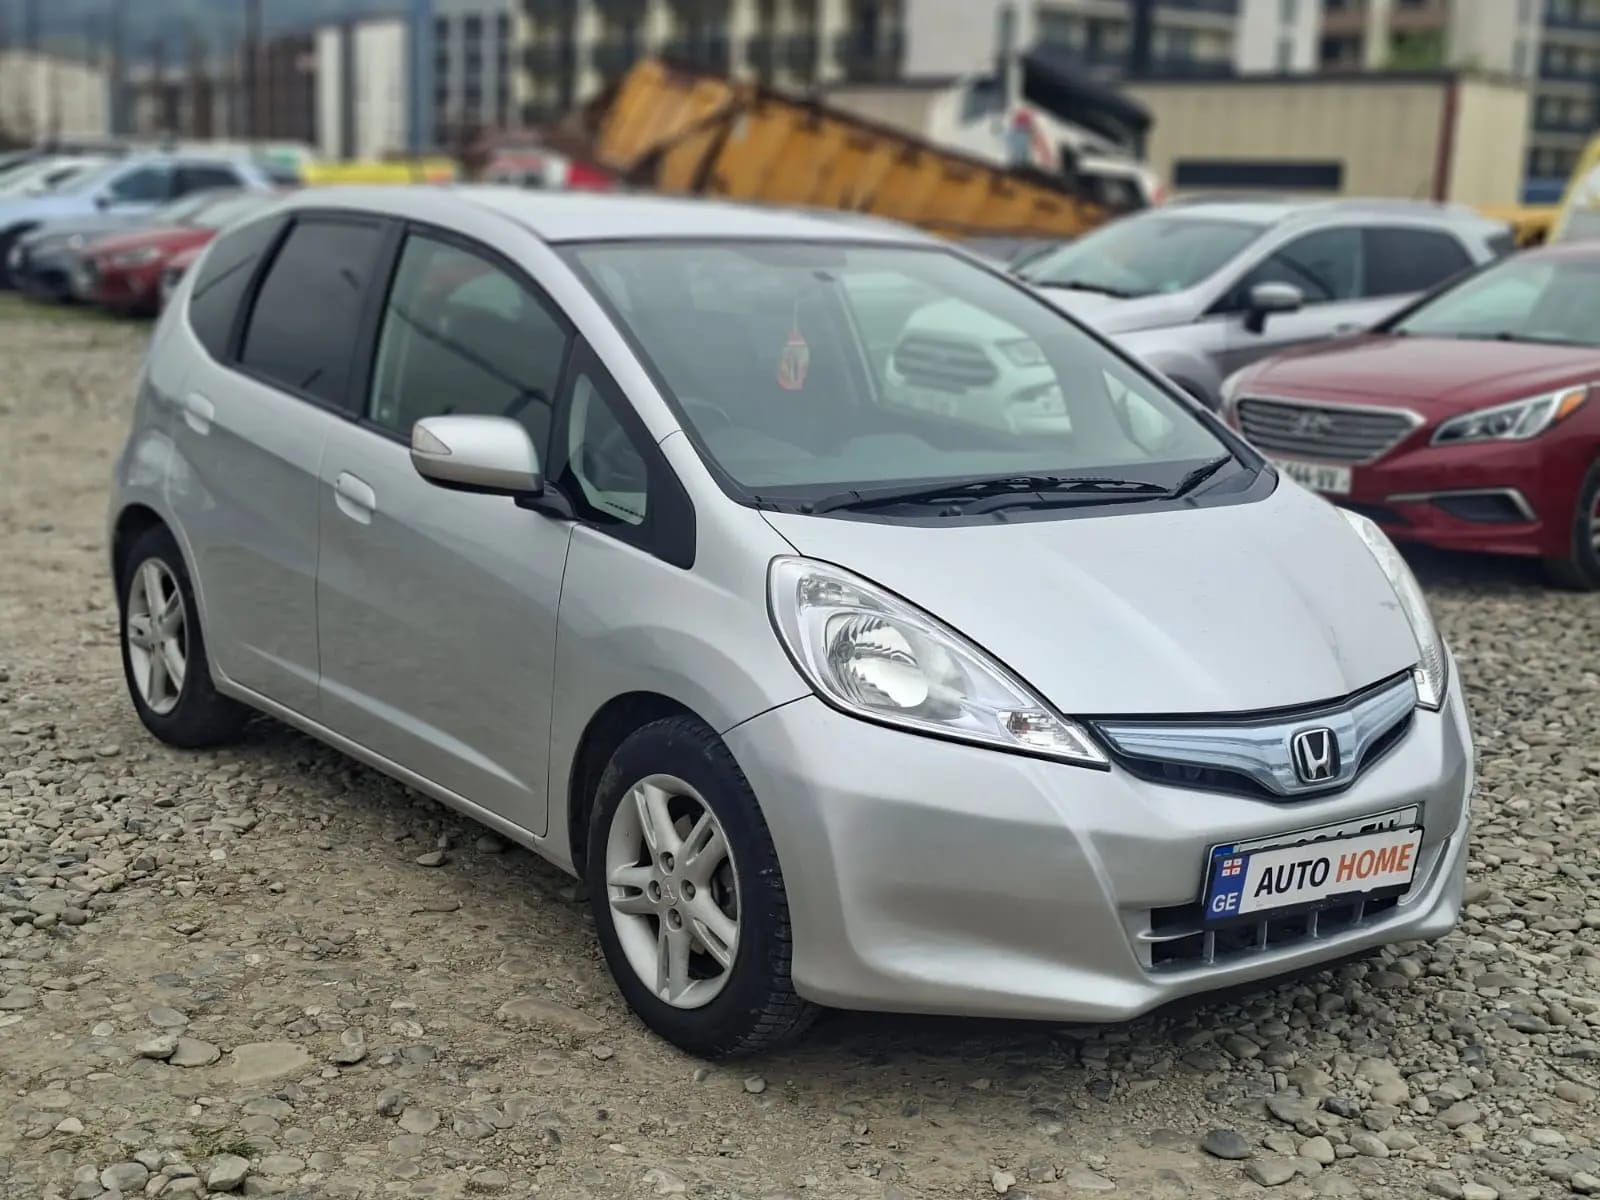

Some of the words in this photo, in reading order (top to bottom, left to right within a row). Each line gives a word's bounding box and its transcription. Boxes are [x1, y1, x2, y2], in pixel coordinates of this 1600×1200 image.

[1254, 857, 1330, 897] AUTO
[1336, 843, 1414, 882] HOME
[1212, 892, 1238, 912] GE
